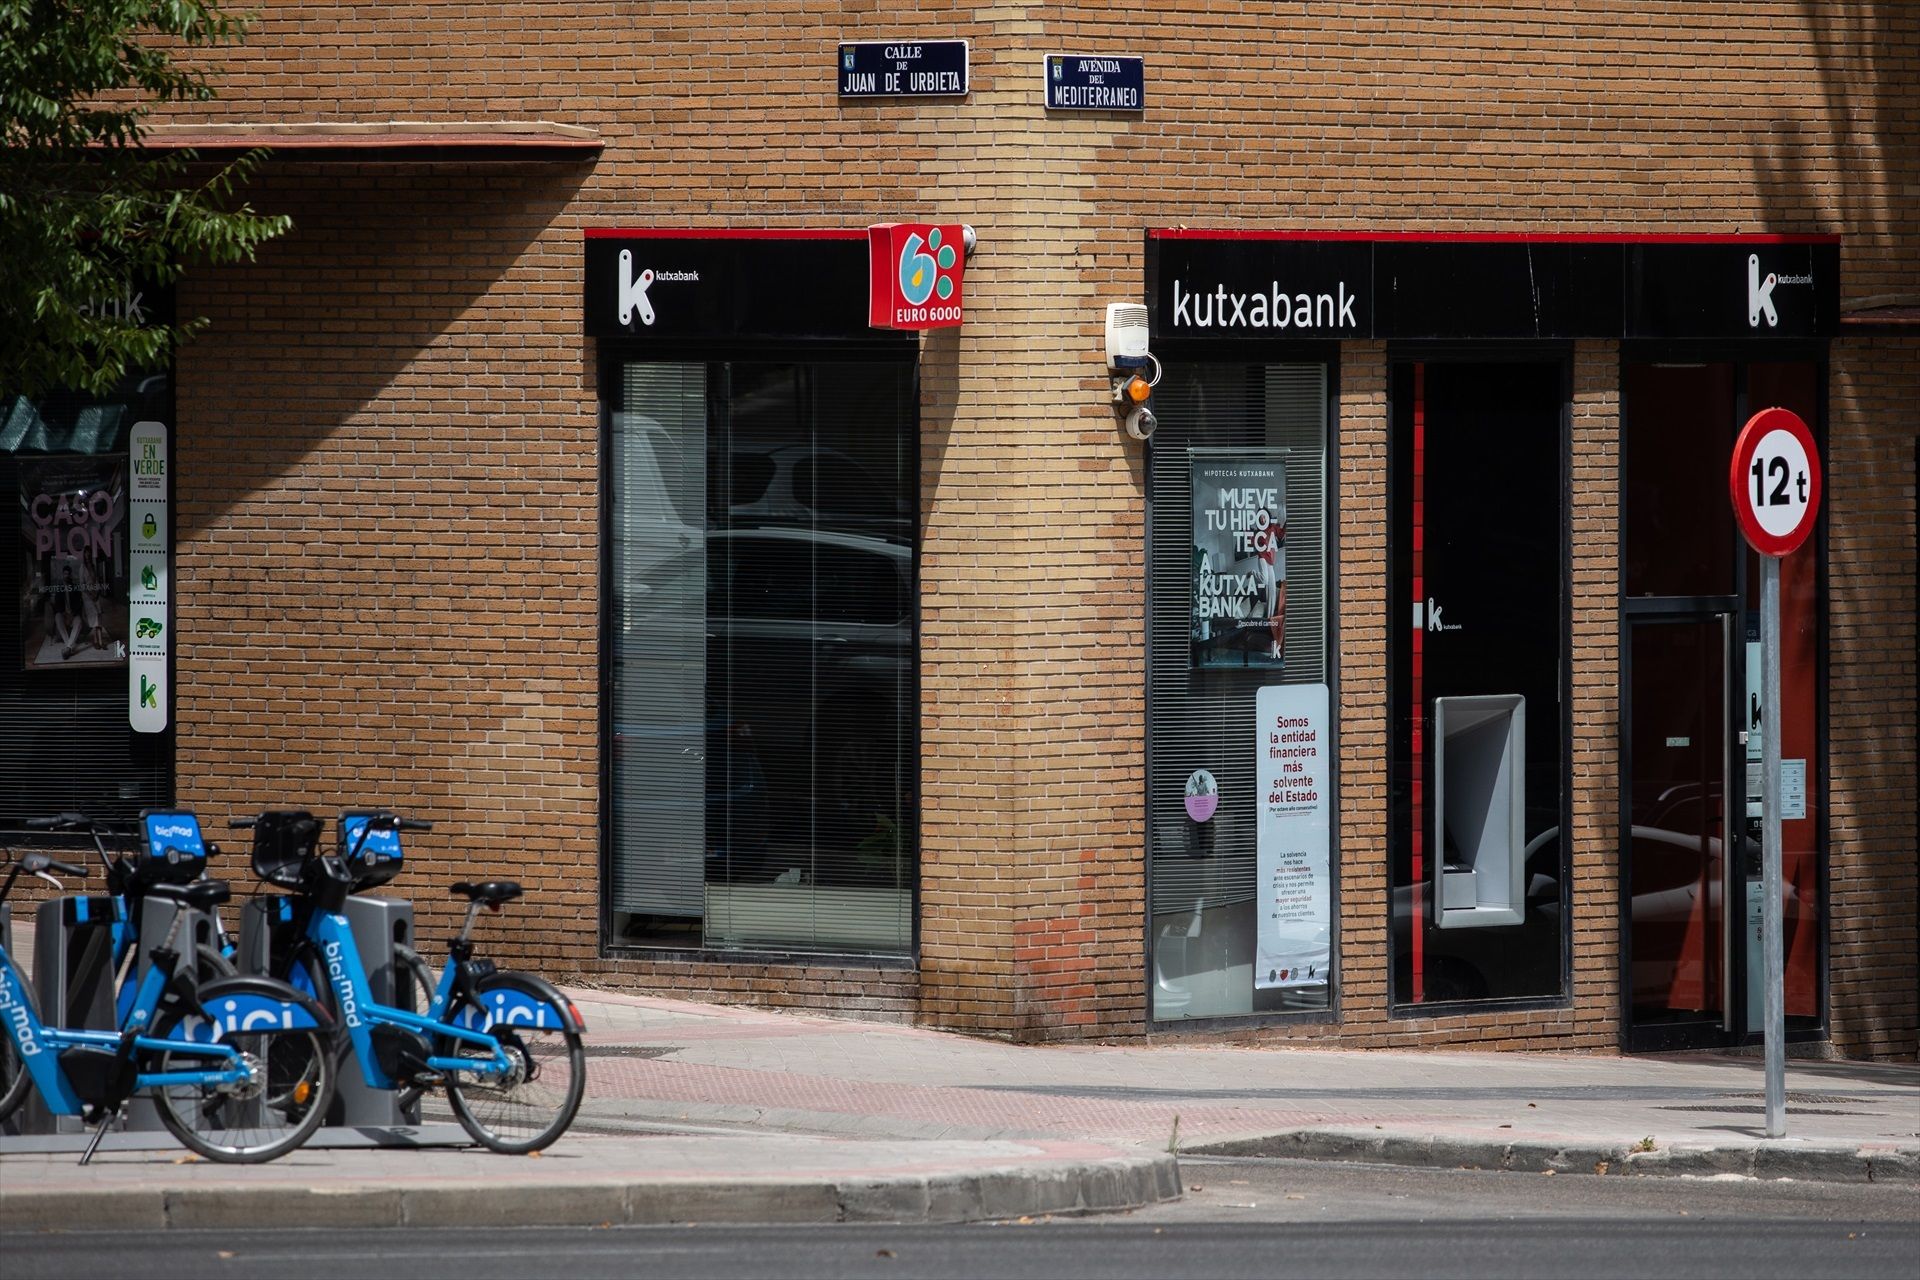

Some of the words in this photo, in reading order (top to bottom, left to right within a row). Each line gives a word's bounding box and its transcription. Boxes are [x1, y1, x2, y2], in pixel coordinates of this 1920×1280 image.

[884, 46, 922, 59] CALLE
[896, 62, 908, 71] DE
[1078, 59, 1121, 73] AVENIDA
[844, 73, 876, 93] JUAN
[885, 72, 901, 92] DE
[910, 71, 961, 92] URBIETA
[1089, 74, 1104, 84] DEL
[1055, 85, 1137, 107] MEDITERRANEO
[656, 269, 699, 282] kutxabank
[1777, 273, 1813, 284] kutxabank
[1174, 279, 1356, 328] kutxabank
[896, 308, 928, 323] EURO
[929, 305, 961, 322] 6000
[143, 444, 156, 459] EN
[134, 460, 165, 475] VERDE
[1239, 470, 1275, 478] KUTXABANK
[1752, 456, 1790, 507] 12
[1796, 471, 1807, 503] t
[1221, 488, 1278, 510] MUEVE
[31, 490, 114, 526] CASO
[1205, 510, 1227, 531] TU
[1230, 509, 1277, 531] HIPO-
[1233, 532, 1279, 553] TECA
[1200, 553, 1212, 575] A
[38, 584, 73, 593] HIPOTECAS
[1199, 574, 1266, 597] KUTXA-
[1199, 596, 1245, 618] BANK
[1277, 716, 1309, 728] Somos
[1270, 732, 1279, 744] la
[1281, 730, 1316, 743] entidad
[1269, 746, 1317, 758] financiera
[1283, 760, 1303, 773] más
[1273, 776, 1313, 788] solvente
[1269, 792, 1284, 804] del
[1286, 790, 1318, 803] Estado
